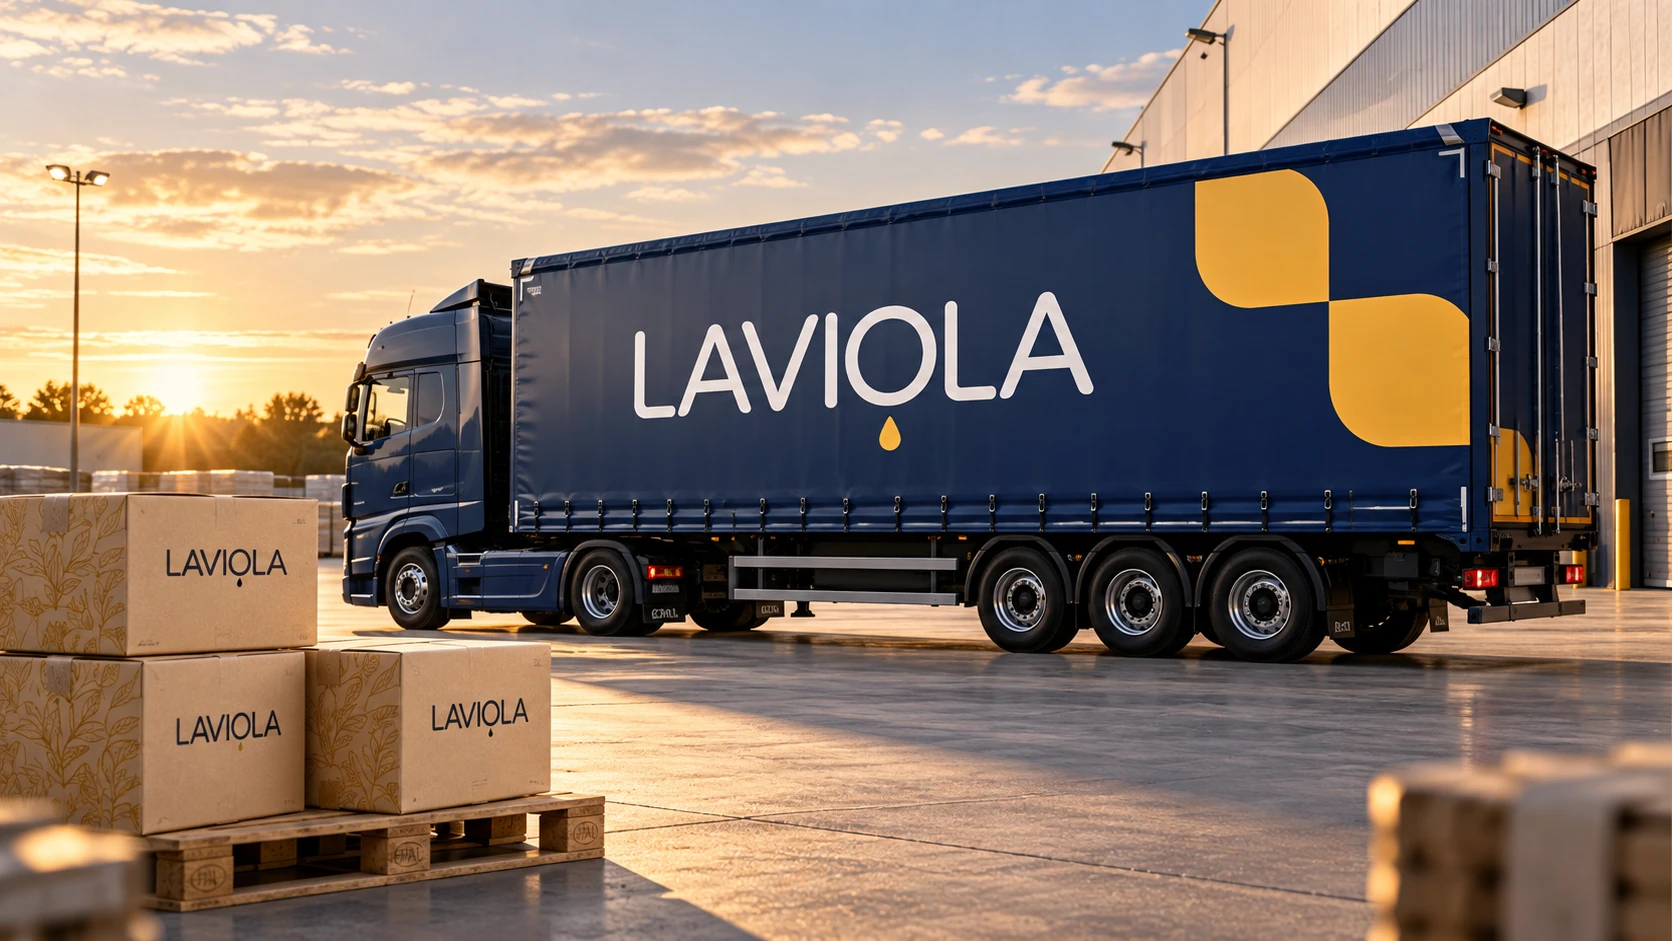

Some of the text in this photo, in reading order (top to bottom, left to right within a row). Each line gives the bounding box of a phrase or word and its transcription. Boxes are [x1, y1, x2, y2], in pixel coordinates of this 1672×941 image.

[633, 291, 1094, 419] LAVIOLA
[166, 548, 288, 577] LAVIOLA
[175, 709, 282, 746] LAVIOLA
[431, 697, 529, 732] LAVIOLA
